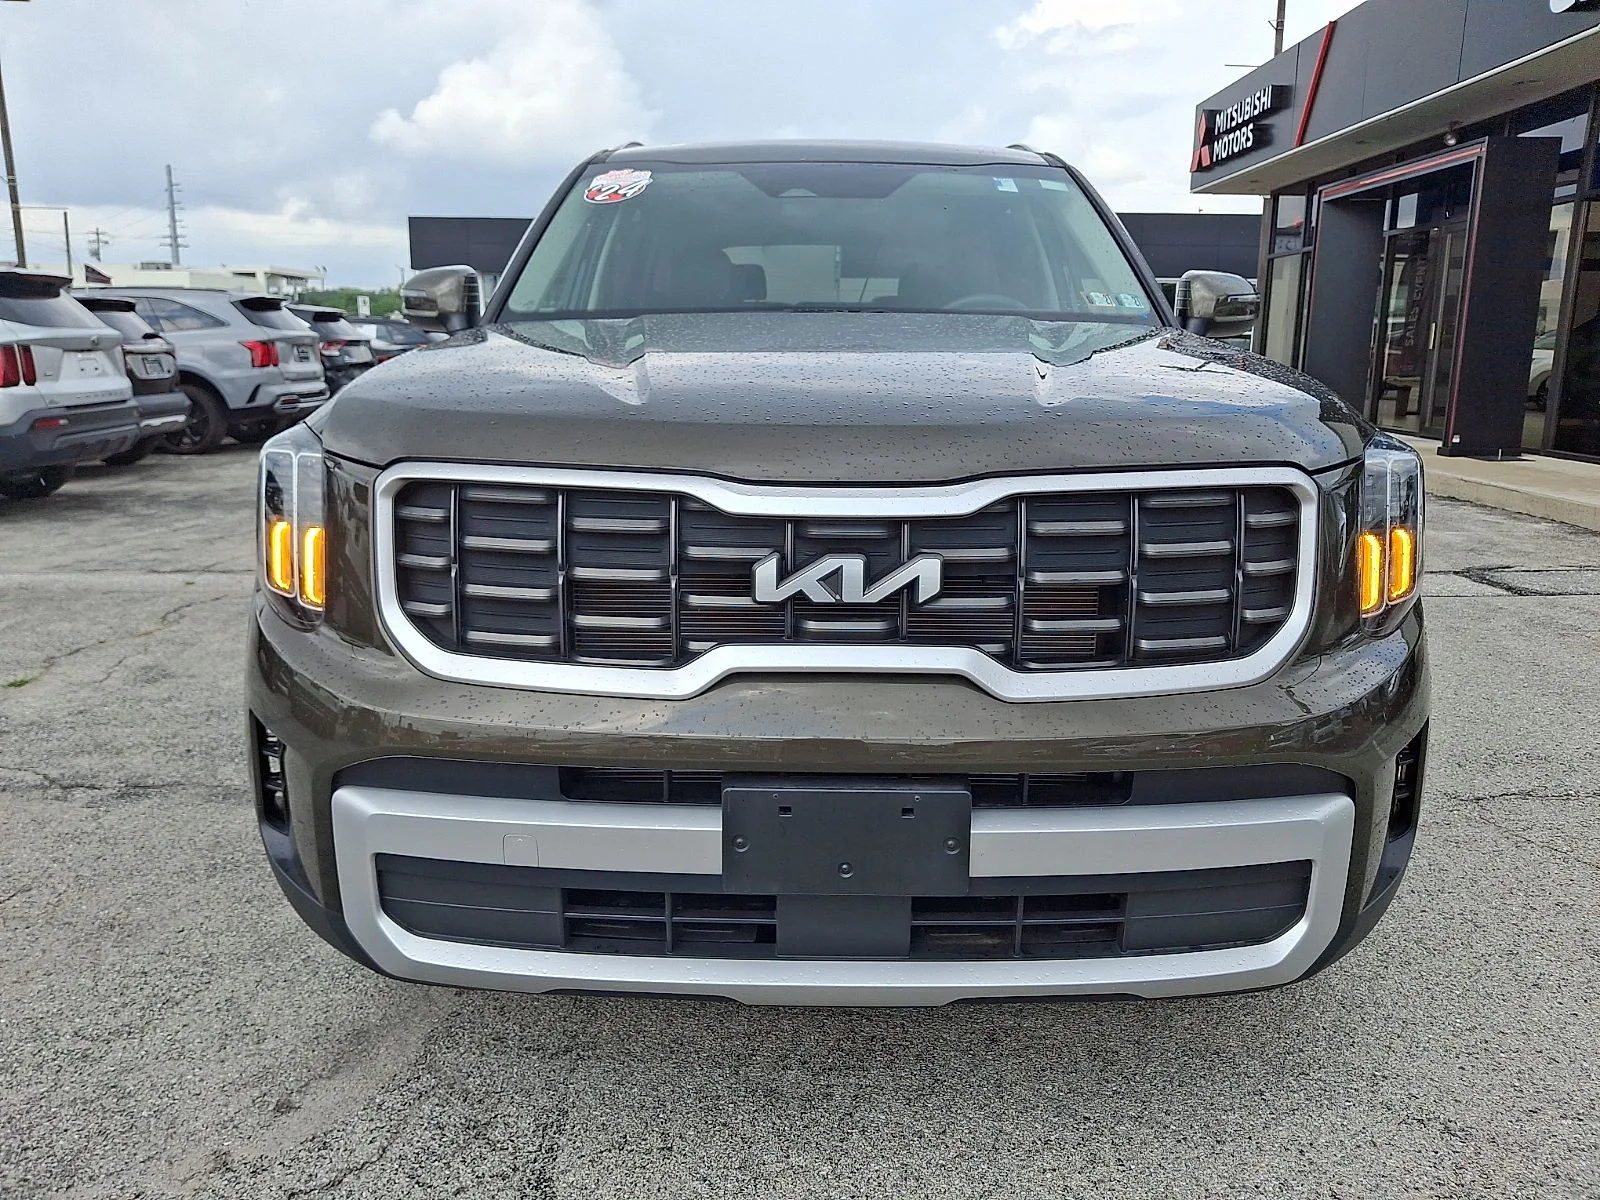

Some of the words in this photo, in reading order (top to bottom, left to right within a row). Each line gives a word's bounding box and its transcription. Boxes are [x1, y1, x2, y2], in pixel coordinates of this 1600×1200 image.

[1215, 85, 1272, 135] MITSUBISHI
[1213, 122, 1254, 162] MOTORS
[1405, 306, 1420, 347] SALES
[752, 552, 944, 605] KIA
